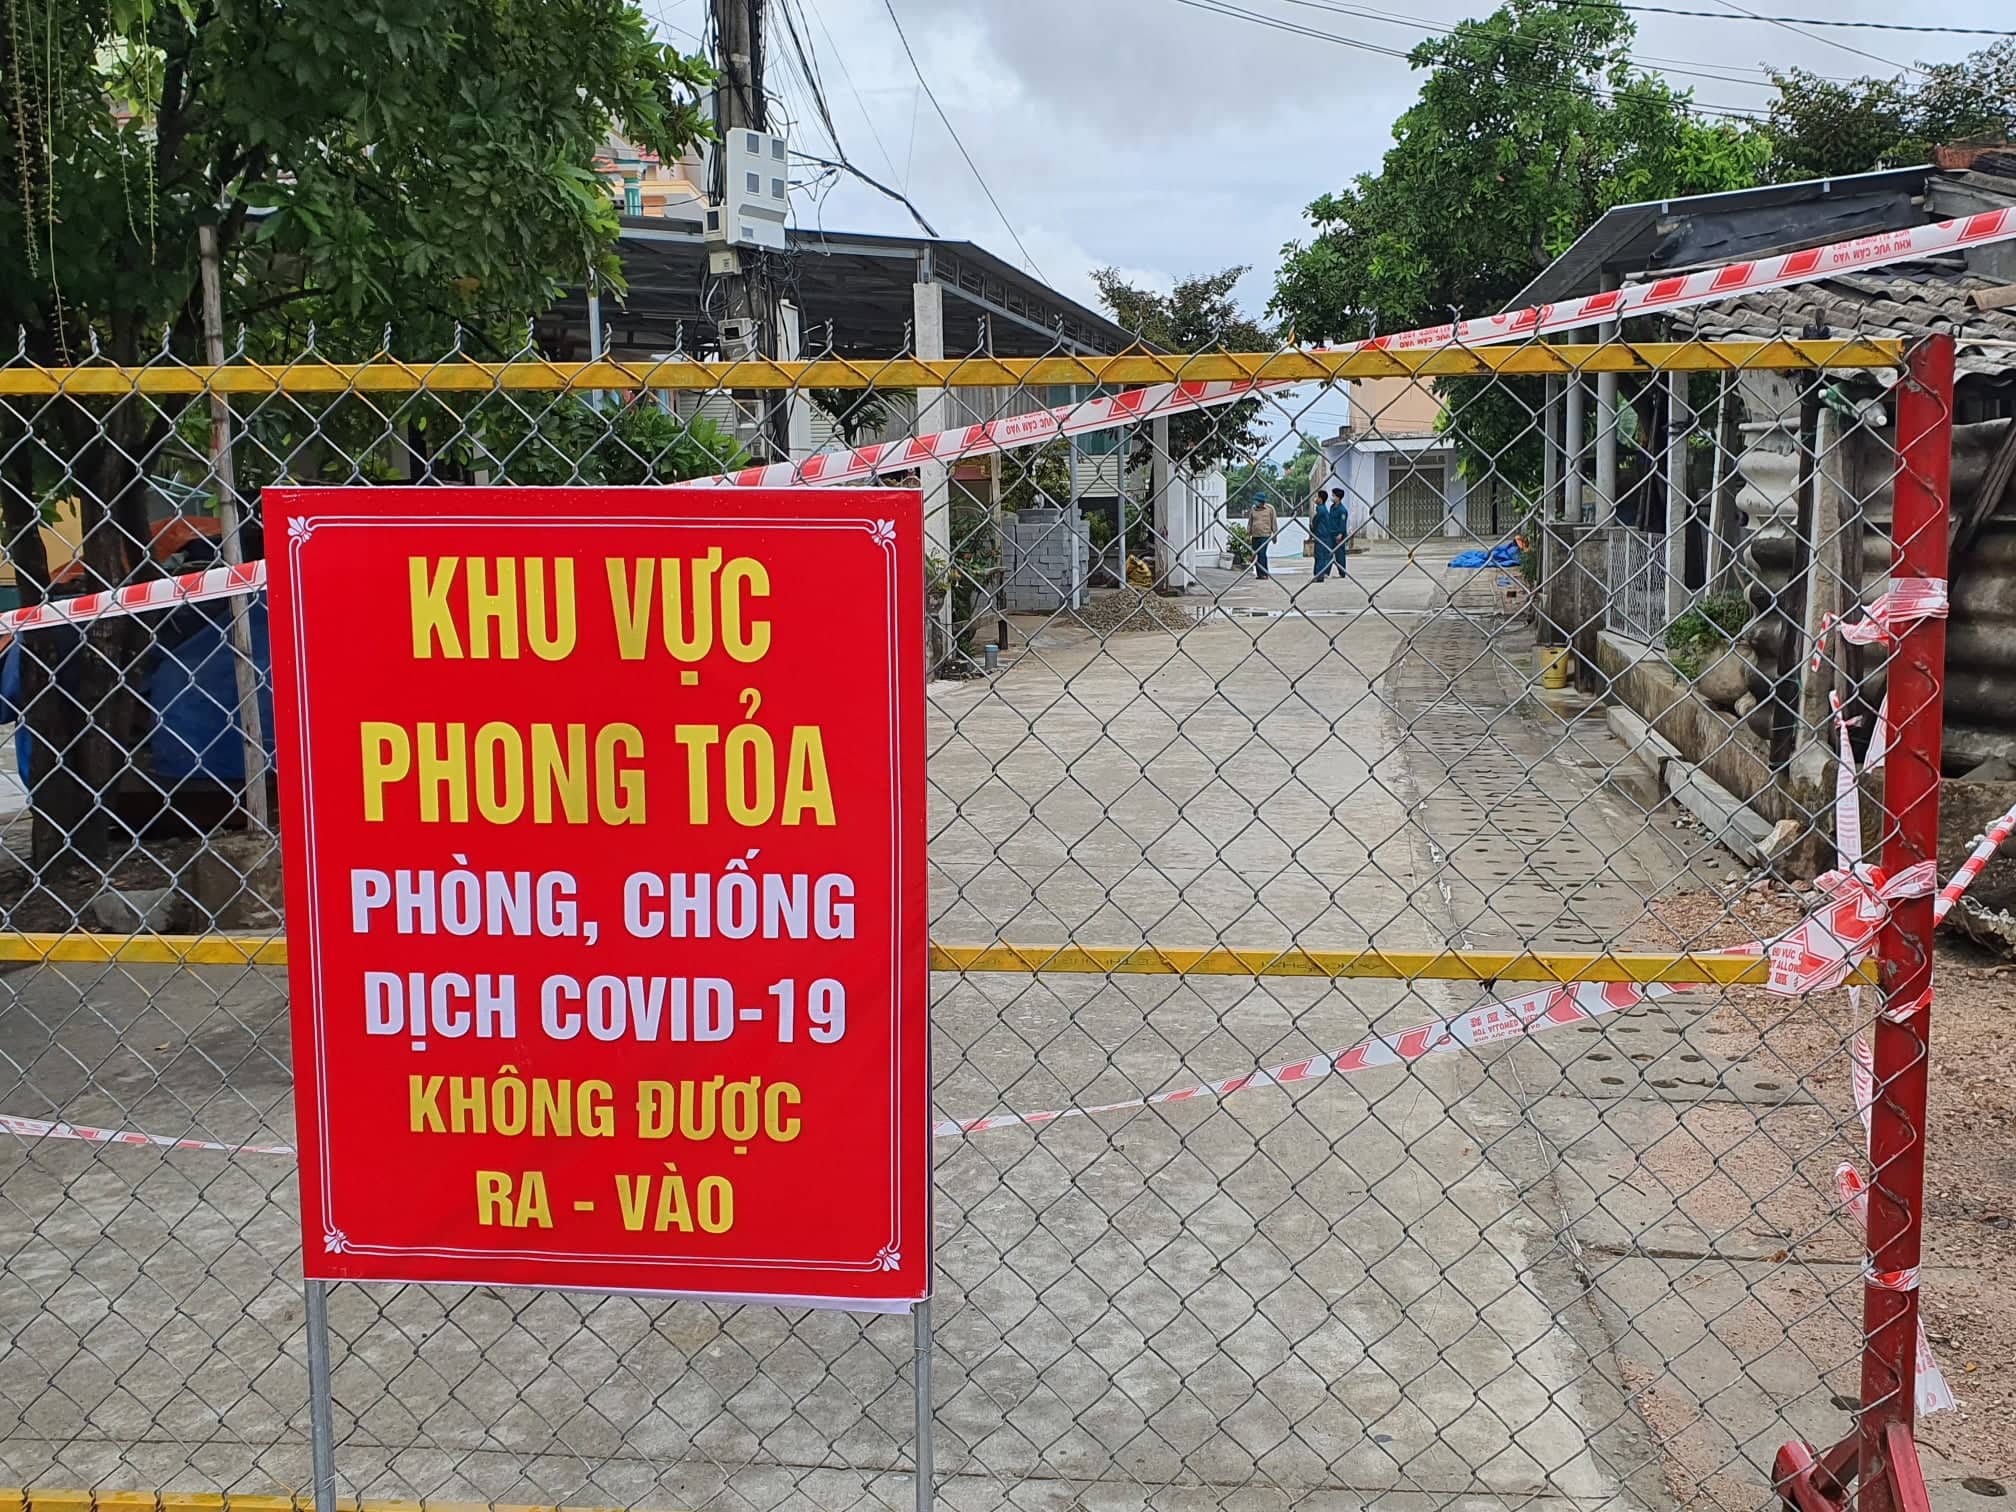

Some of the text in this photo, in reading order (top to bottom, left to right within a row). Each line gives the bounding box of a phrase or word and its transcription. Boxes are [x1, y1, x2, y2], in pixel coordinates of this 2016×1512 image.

[1894, 239, 1912, 250] KHU
[409, 547, 770, 686] KHU VỰC
[361, 688, 836, 826] PHONG TỎA
[351, 849, 854, 945] PHÒNG, CHỐNG
[365, 972, 845, 1051] DỊCH COVID-19
[410, 1065, 800, 1154] KHÔNG ĐƯỢC
[477, 1163, 733, 1233] RA - VÀO
